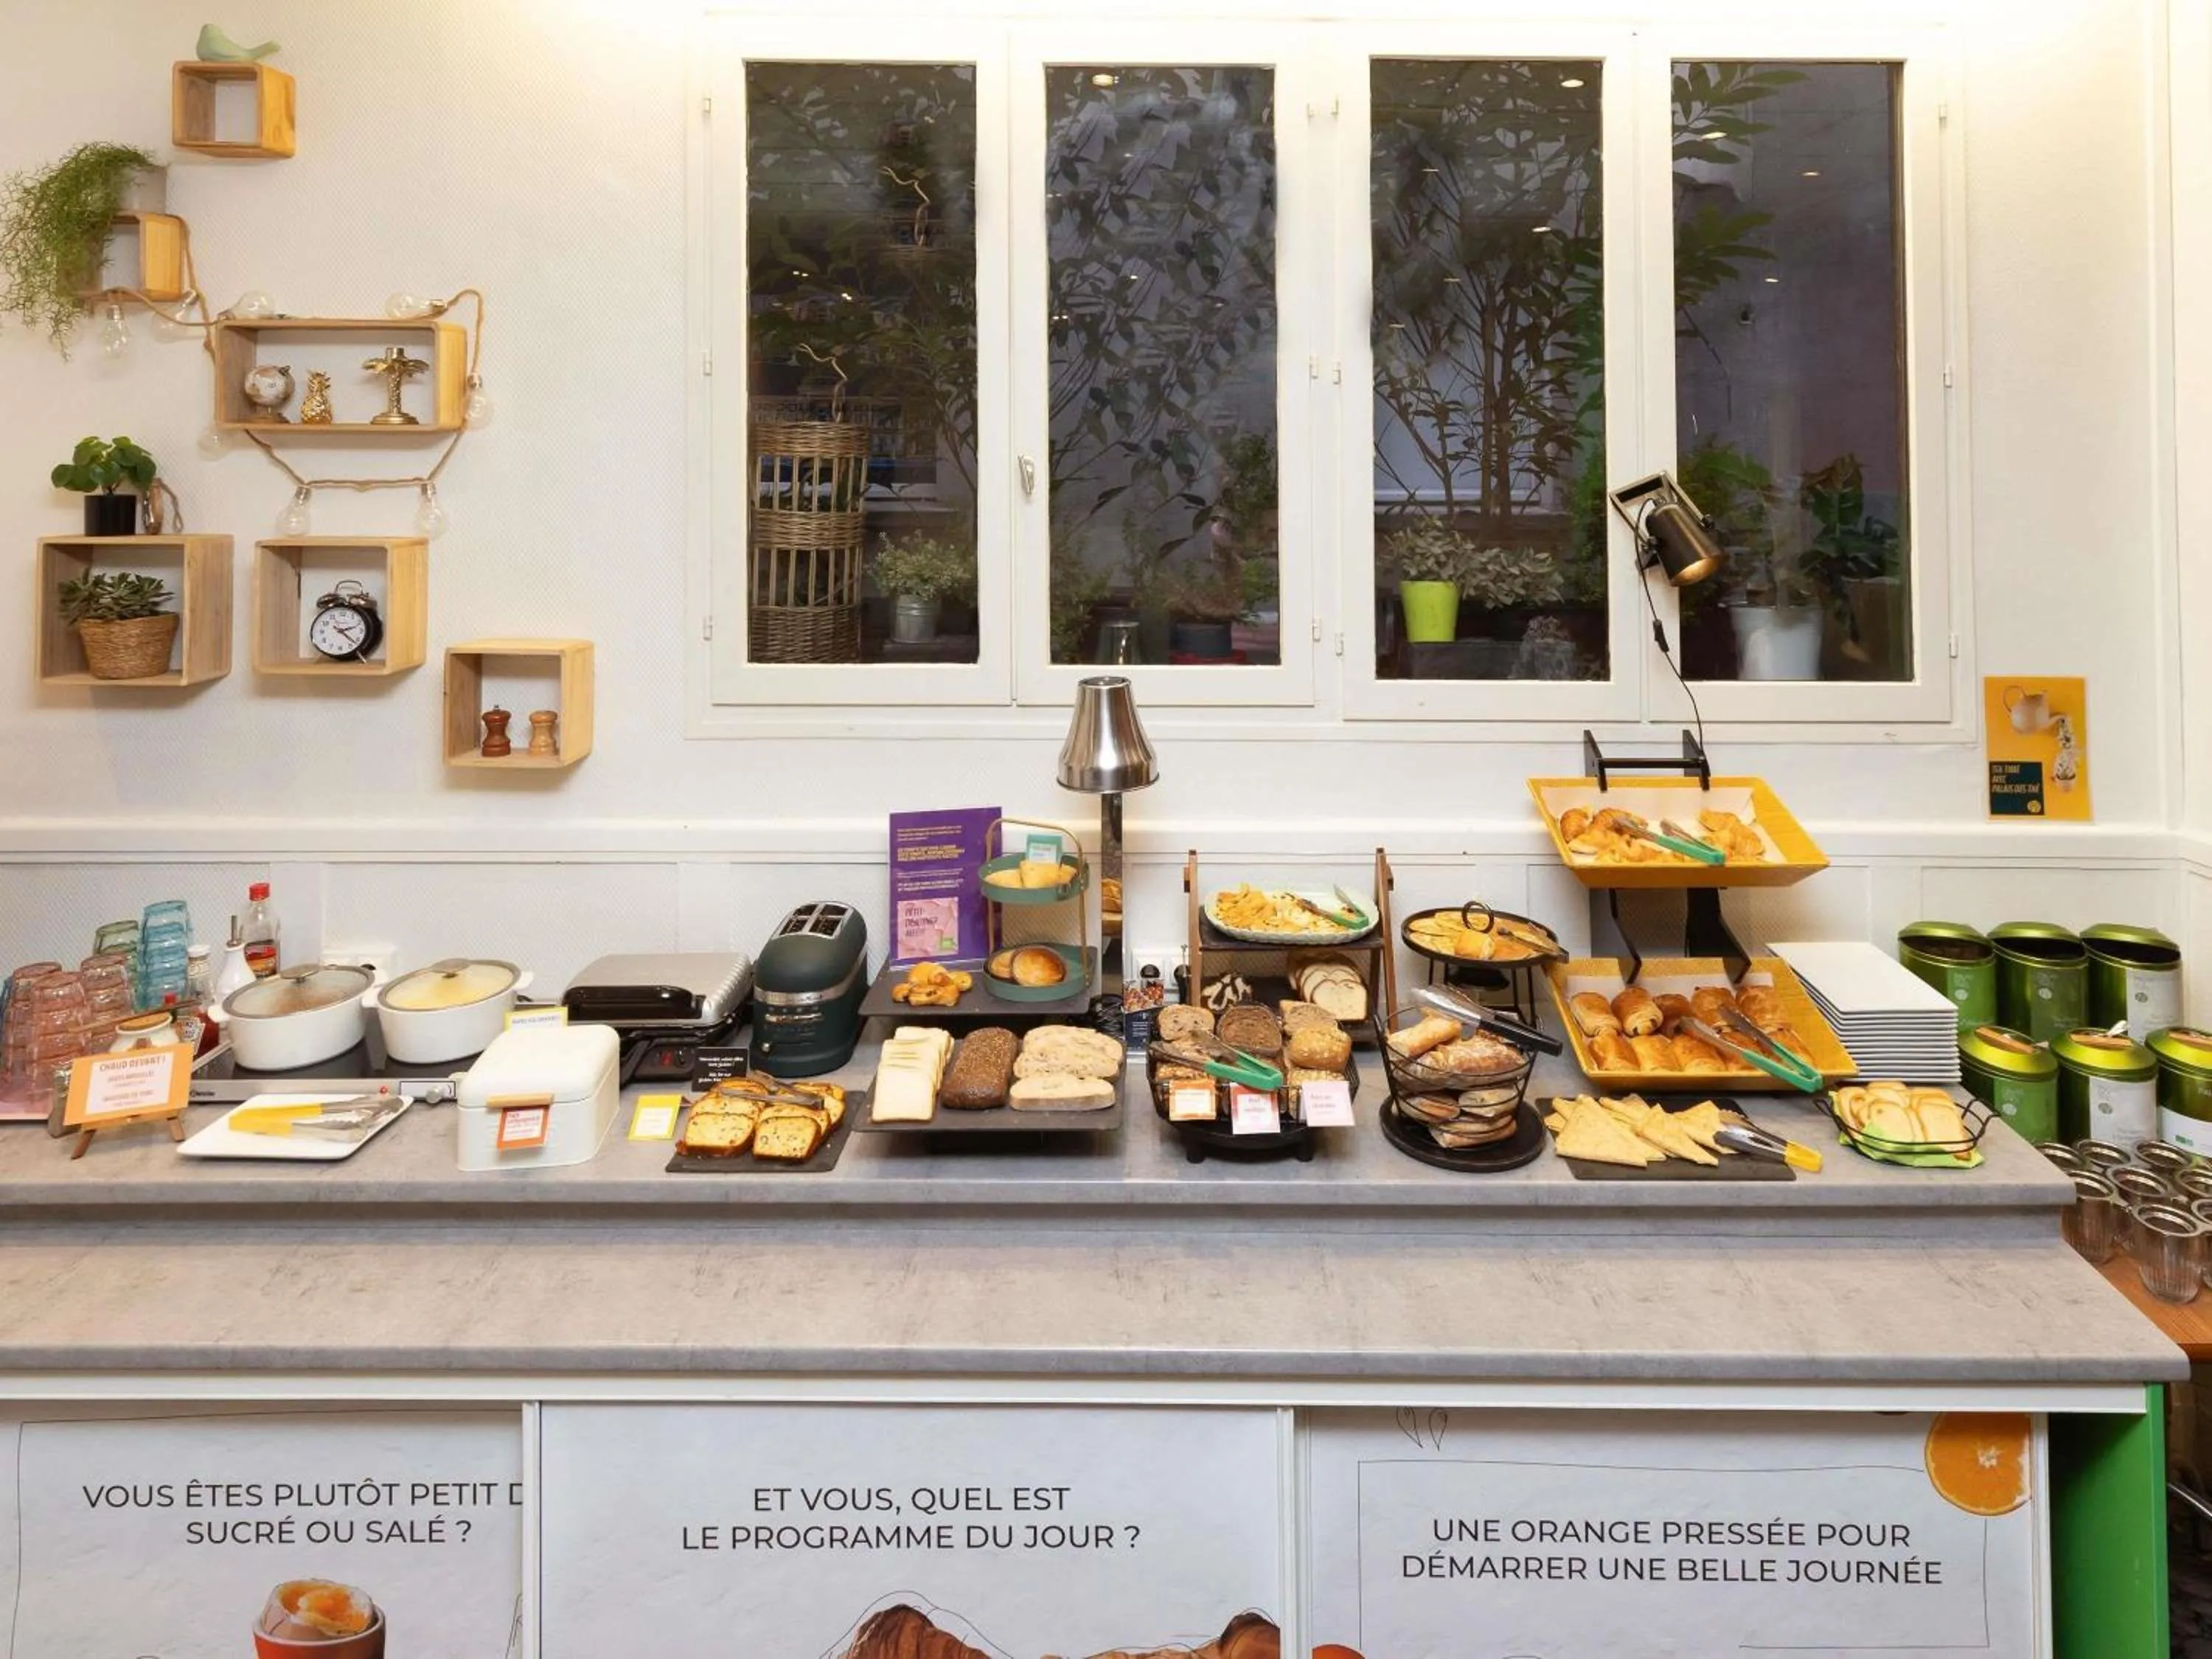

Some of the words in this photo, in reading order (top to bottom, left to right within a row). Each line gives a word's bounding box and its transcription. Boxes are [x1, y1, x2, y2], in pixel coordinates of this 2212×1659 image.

[82, 1484, 175, 1509] VOUS
[186, 1478, 263, 1508] ÊTES
[275, 1478, 400, 1507] PLUTÔT
[411, 1483, 498, 1506] PETIT
[754, 1488, 792, 1512] ET
[800, 1487, 901, 1515] VOUS,
[911, 1487, 1003, 1515] QUEL
[1014, 1487, 1071, 1511] EST
[187, 1515, 296, 1545] SUCRÉ
[306, 1520, 354, 1543] OU
[366, 1514, 445, 1543] SALÉ
[455, 1520, 472, 1543] ?
[683, 1526, 720, 1550] LE
[732, 1525, 954, 1550] PROGRAMME
[967, 1525, 1012, 1548] DU
[1023, 1525, 1114, 1548] JOUR
[1124, 1526, 1140, 1548] ?
[1433, 1519, 1500, 1543] UNE
[1511, 1520, 1651, 1545] ORANGE
[1663, 1517, 1806, 1546] PRESSÉE
[1818, 1523, 1910, 1548] POUR
[1403, 1549, 1587, 1581] DÉMARRER
[1599, 1557, 1666, 1582] UNE
[1678, 1558, 1777, 1583] BELLE
[1786, 1555, 1942, 1585] JOURNÉE
